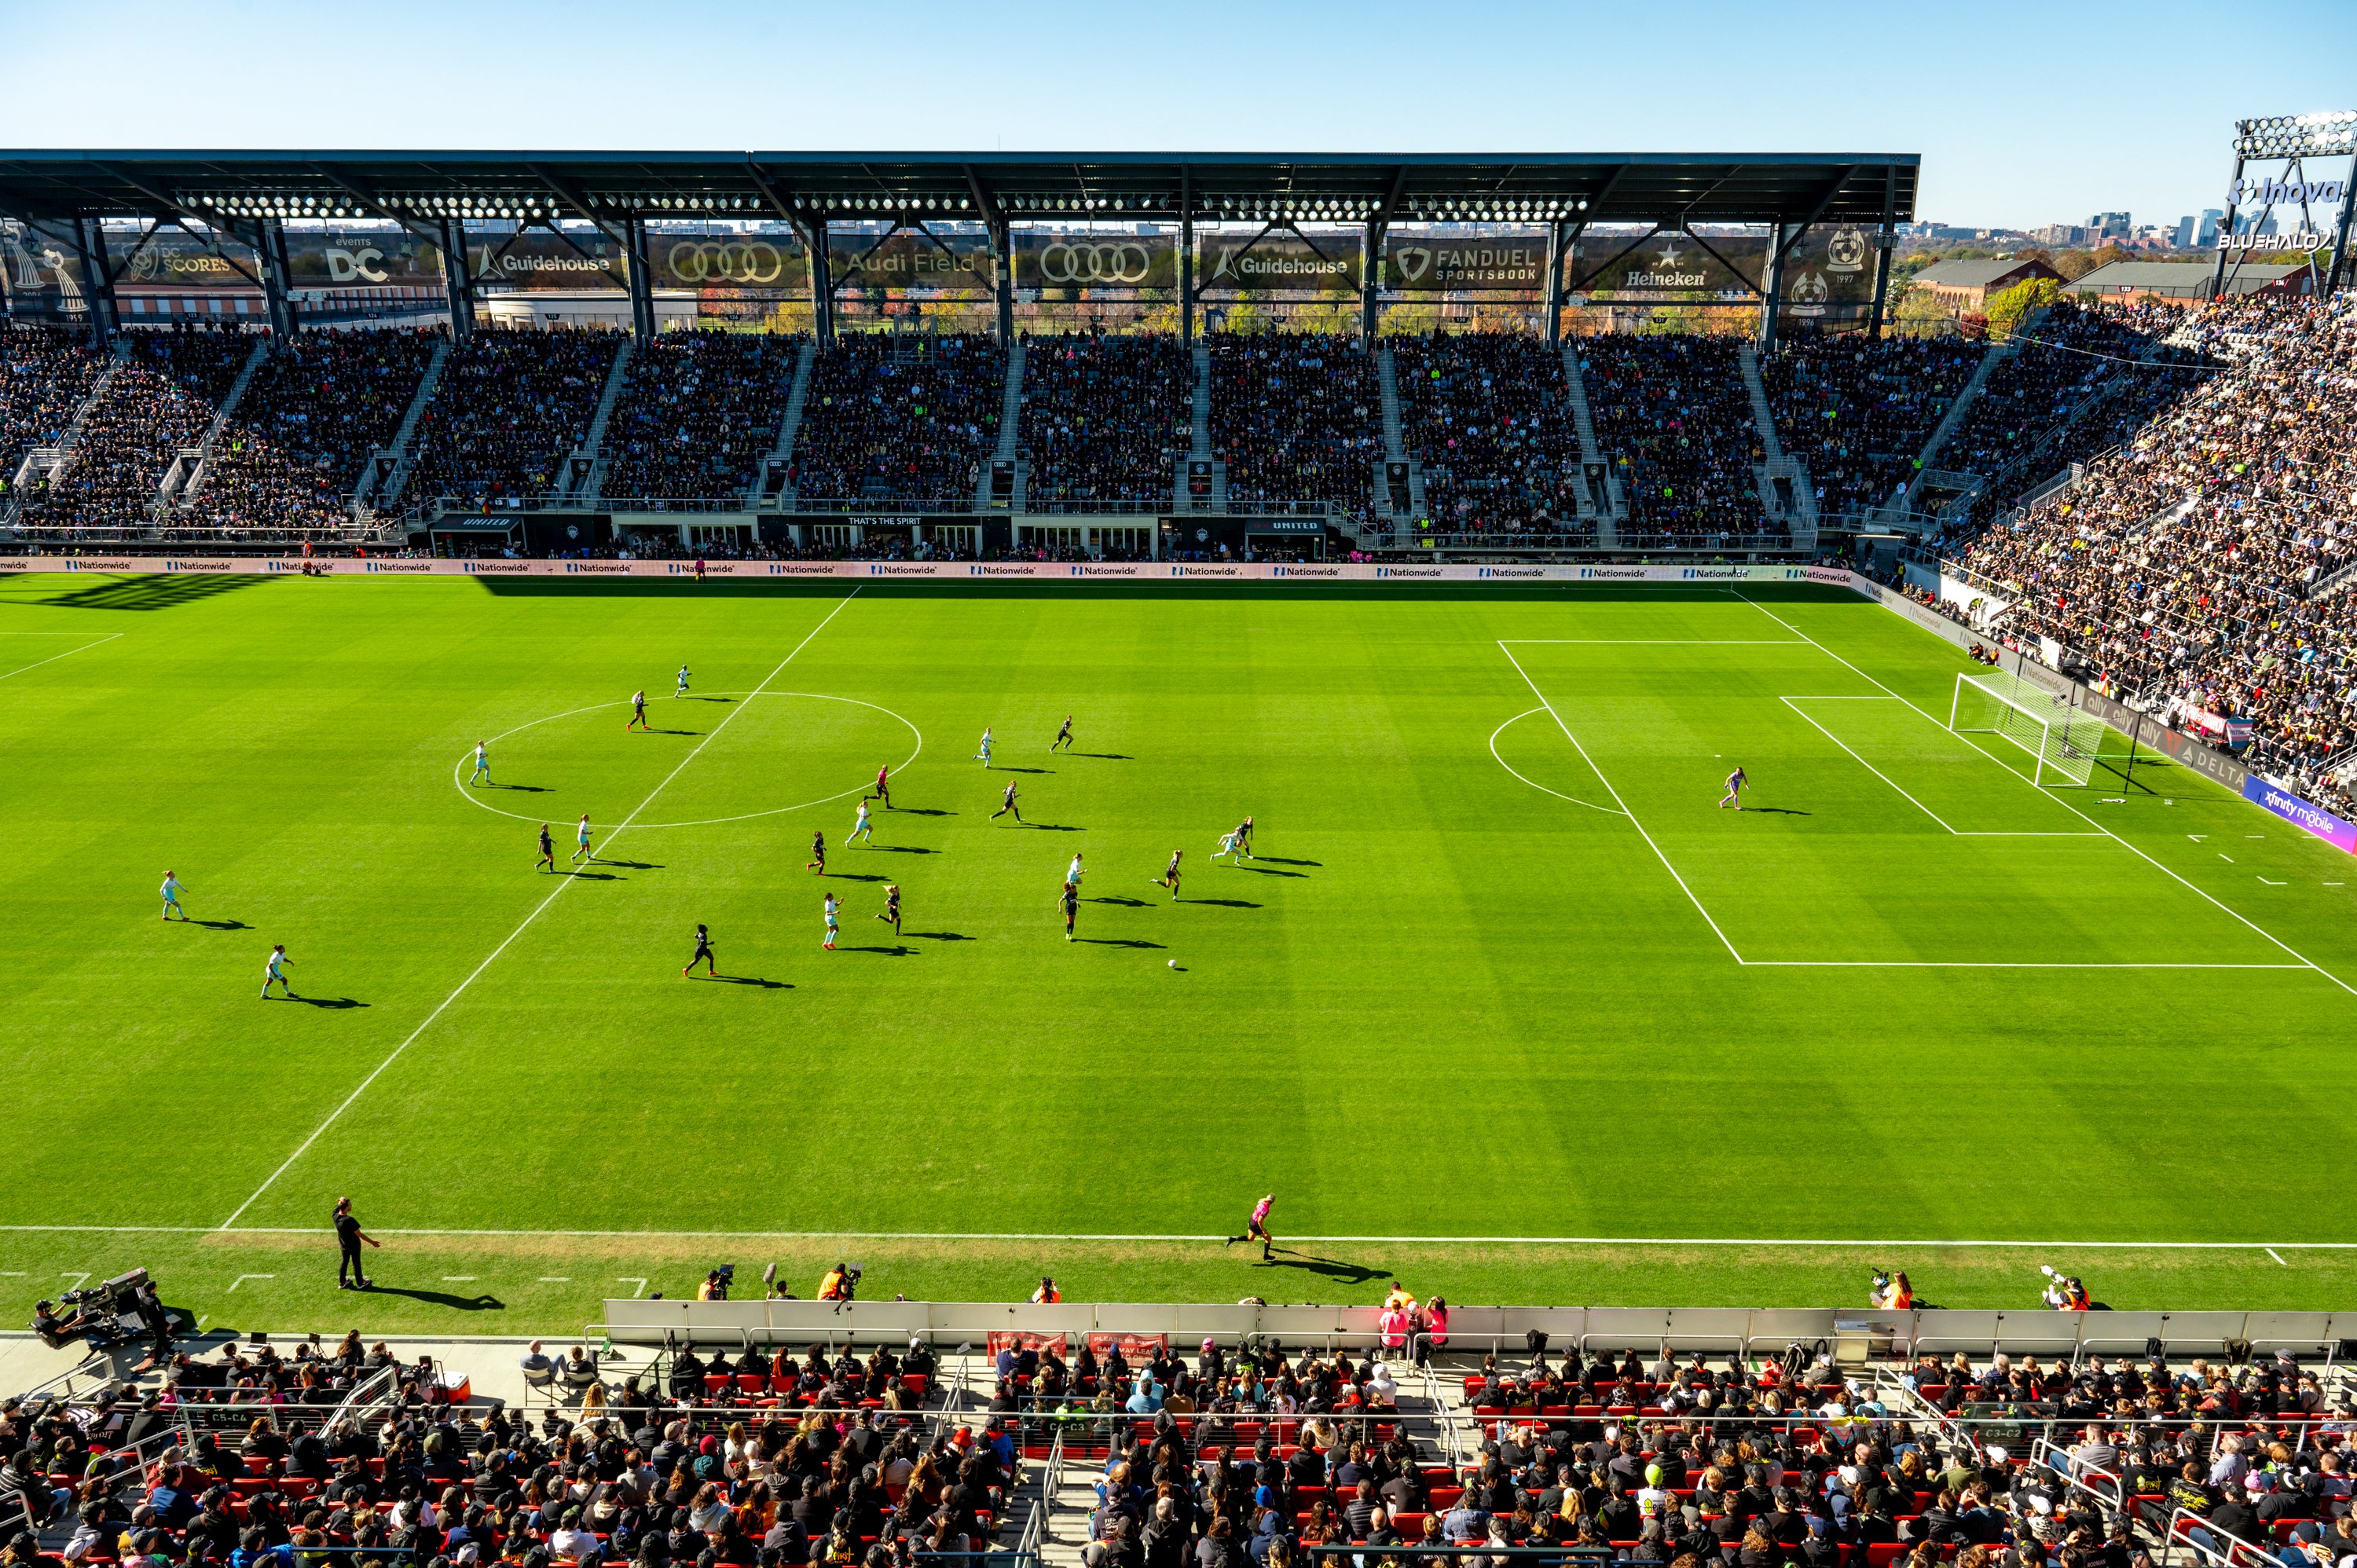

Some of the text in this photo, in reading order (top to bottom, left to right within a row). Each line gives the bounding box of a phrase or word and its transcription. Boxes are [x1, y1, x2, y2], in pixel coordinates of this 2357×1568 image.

[2260, 177, 2344, 204] Inova
[2217, 233, 2320, 250] BLUEHALO
[162, 247, 181, 258] DC
[503, 255, 610, 272] Guidehouse
[846, 252, 976, 272] Audi Field
[1437, 250, 1536, 267] FANDUEL
[163, 258, 230, 272] SCORES
[325, 248, 388, 282] DC
[1241, 256, 1347, 274] Guidehouse
[1436, 269, 1536, 280] SPORTSBOOK
[1626, 271, 1706, 286] Heineken
[1836, 275, 1854, 284] 1997
[1798, 317, 1815, 327] 1996
[849, 517, 921, 526] THAT'S THE SPIRIT
[0, 561, 27, 570] nwide
[79, 561, 130, 570] Nationwide
[179, 562, 230, 570] Nationwide
[281, 562, 333, 571] Natiwide
[379, 562, 430, 572] Nationwide
[477, 563, 528, 572] Nationwide
[579, 563, 631, 573] Nationwide
[783, 565, 834, 573] Nationwide
[884, 565, 936, 574] Nationwide
[984, 566, 1035, 575] Nationwide
[1084, 566, 1136, 575] Nationwide
[1185, 566, 1236, 576] Nationwide
[1287, 567, 1339, 576] Nationwide
[1390, 567, 1442, 577] Nationwide
[1492, 568, 1544, 577] Nationwide
[1594, 568, 1645, 577] Nationwide
[1799, 569, 1851, 583] Nationwide
[1915, 609, 1941, 629] Nationwide
[2026, 665, 2061, 691] Nationwide
[2088, 694, 2161, 746] ally ally ally
[2198, 752, 2245, 787] DELTA
[2265, 790, 2333, 833] xfinity mobile
[212, 1413, 247, 1422] C5-C4
[1985, 1429, 2022, 1438] C3-C2
[2087, 1558, 2106, 1568] RODMAN
